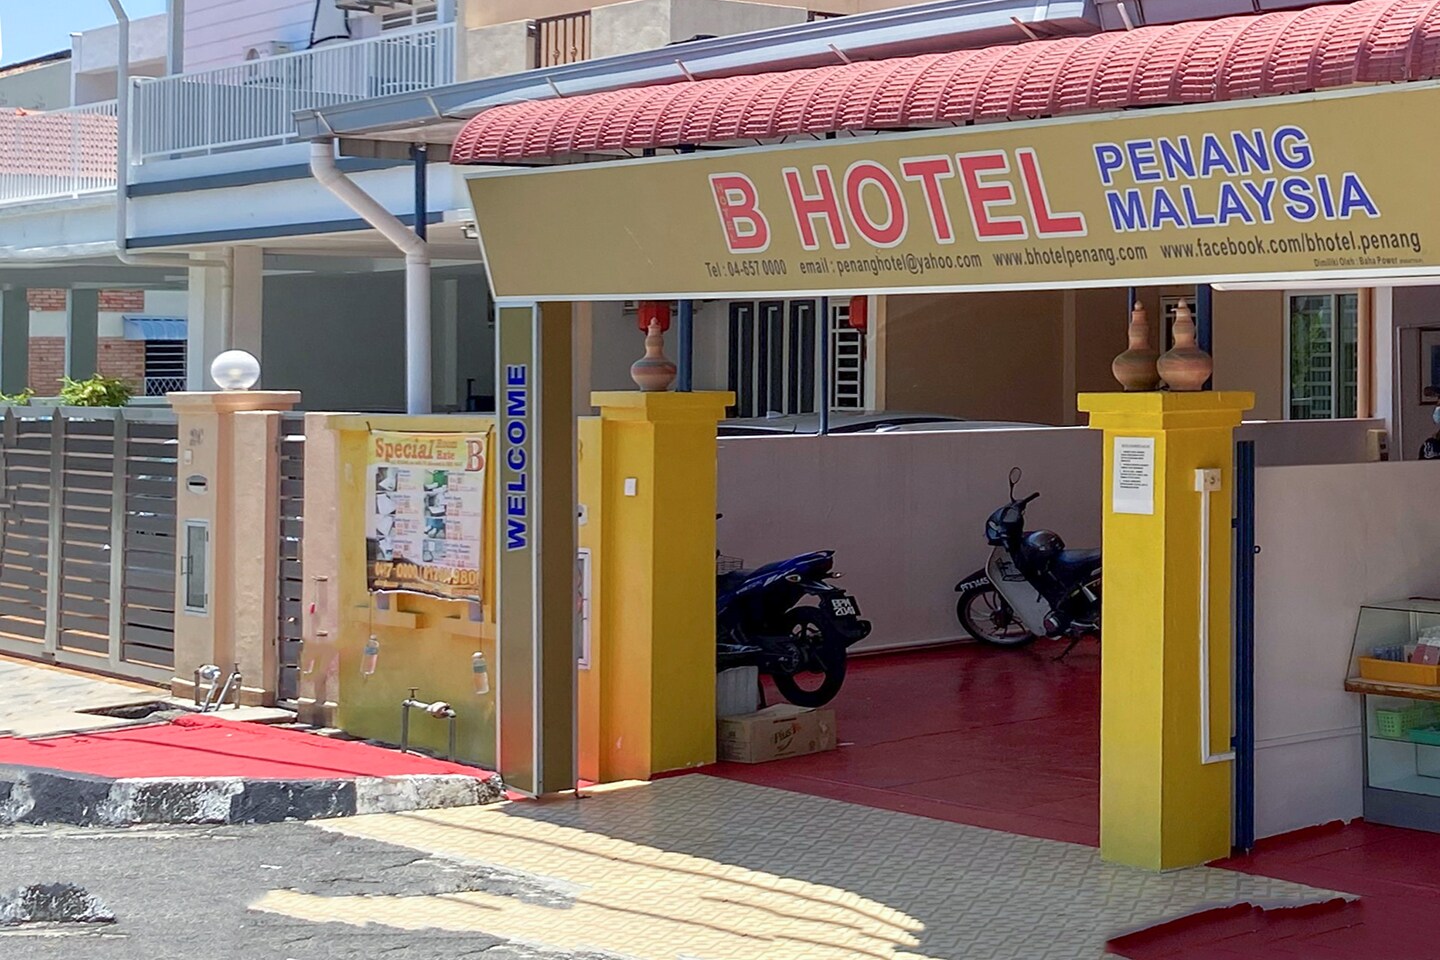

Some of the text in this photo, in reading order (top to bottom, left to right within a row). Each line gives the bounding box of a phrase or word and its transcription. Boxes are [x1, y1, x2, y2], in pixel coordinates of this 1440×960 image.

[1093, 125, 1315, 186] PENANG
[708, 147, 1088, 254] B HOTEL
[1106, 172, 1381, 233] MALAYSIA
[837, 252, 982, 277] penanghotel@yahoo.com
[993, 244, 1148, 268] www.bhotelpenang.com
[1160, 230, 1422, 259] www.facebook.com/bhotel.penang
[375, 437, 436, 462] Special
[464, 438, 486, 472] B
[506, 363, 528, 552] WELCOME
